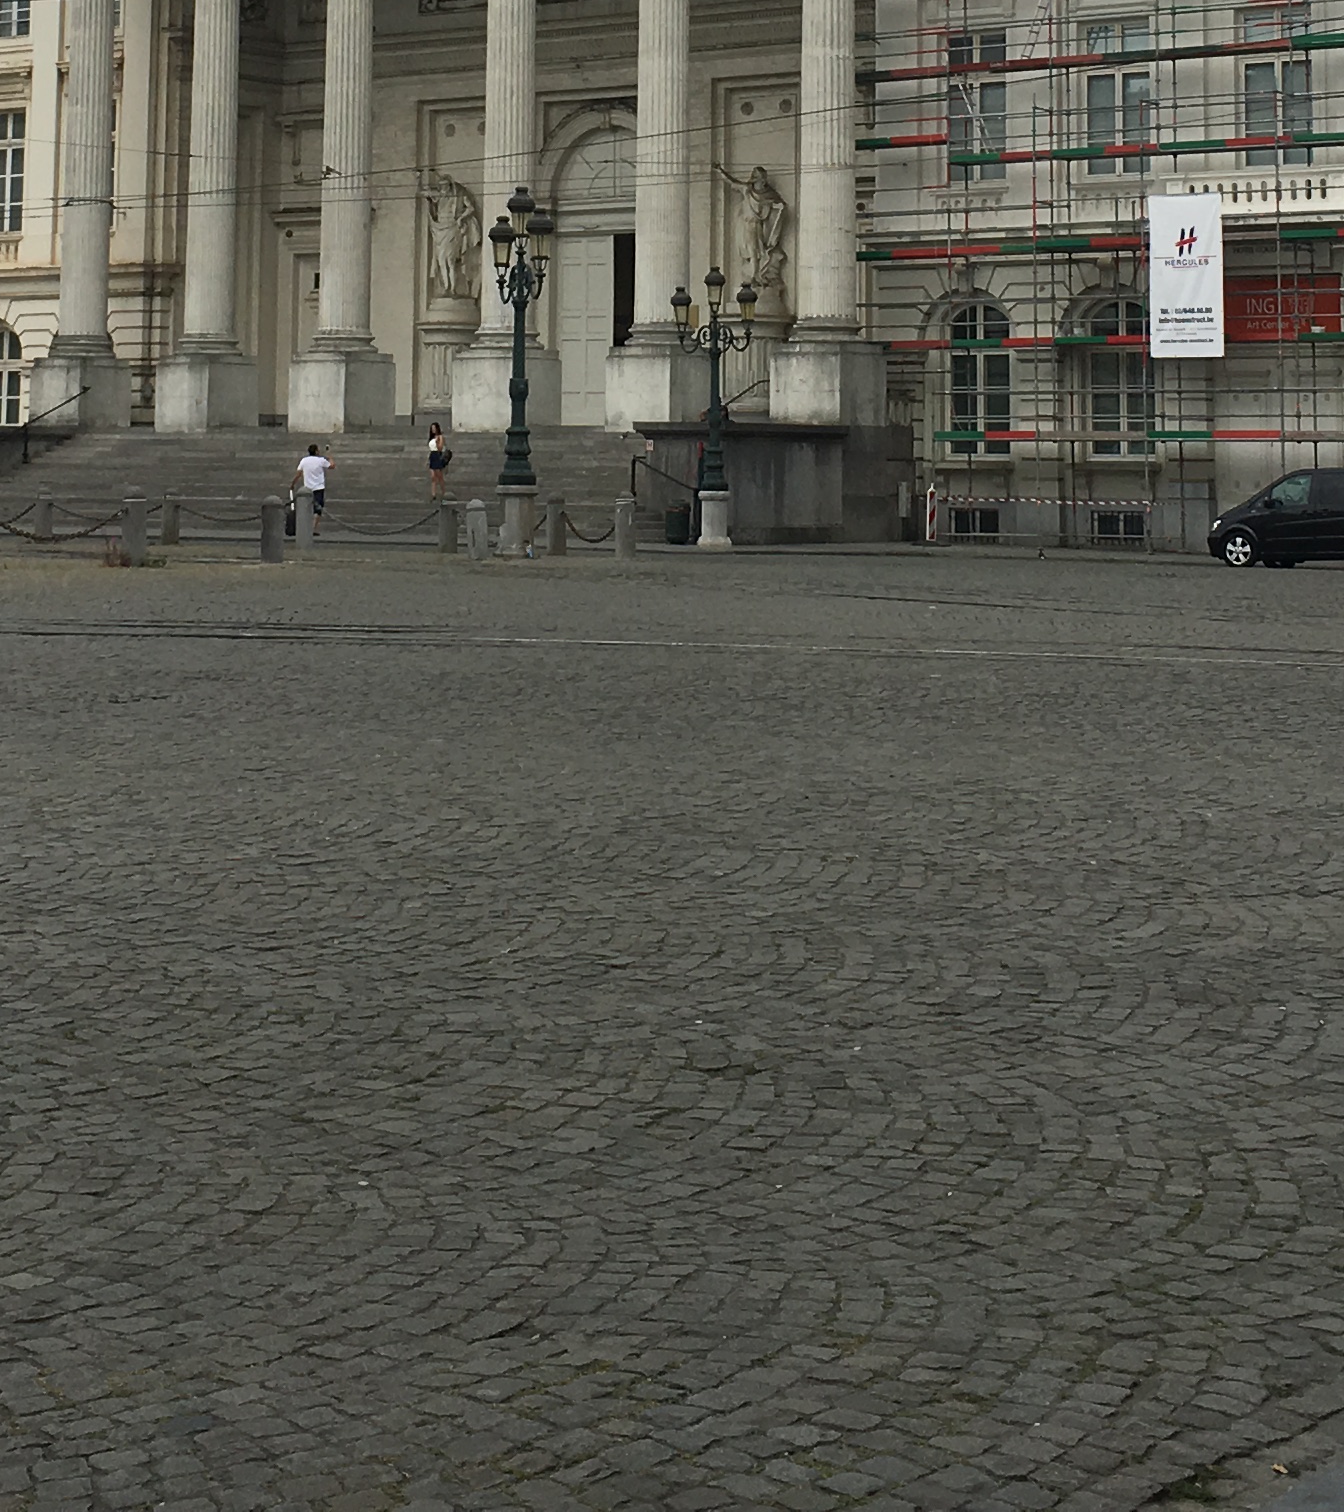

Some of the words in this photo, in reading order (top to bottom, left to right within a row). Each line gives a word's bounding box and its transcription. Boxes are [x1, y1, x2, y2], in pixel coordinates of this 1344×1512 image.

[1164, 258, 1210, 267] HERCULES
[1246, 298, 1275, 315] ING
[1247, 320, 1260, 330] Art
